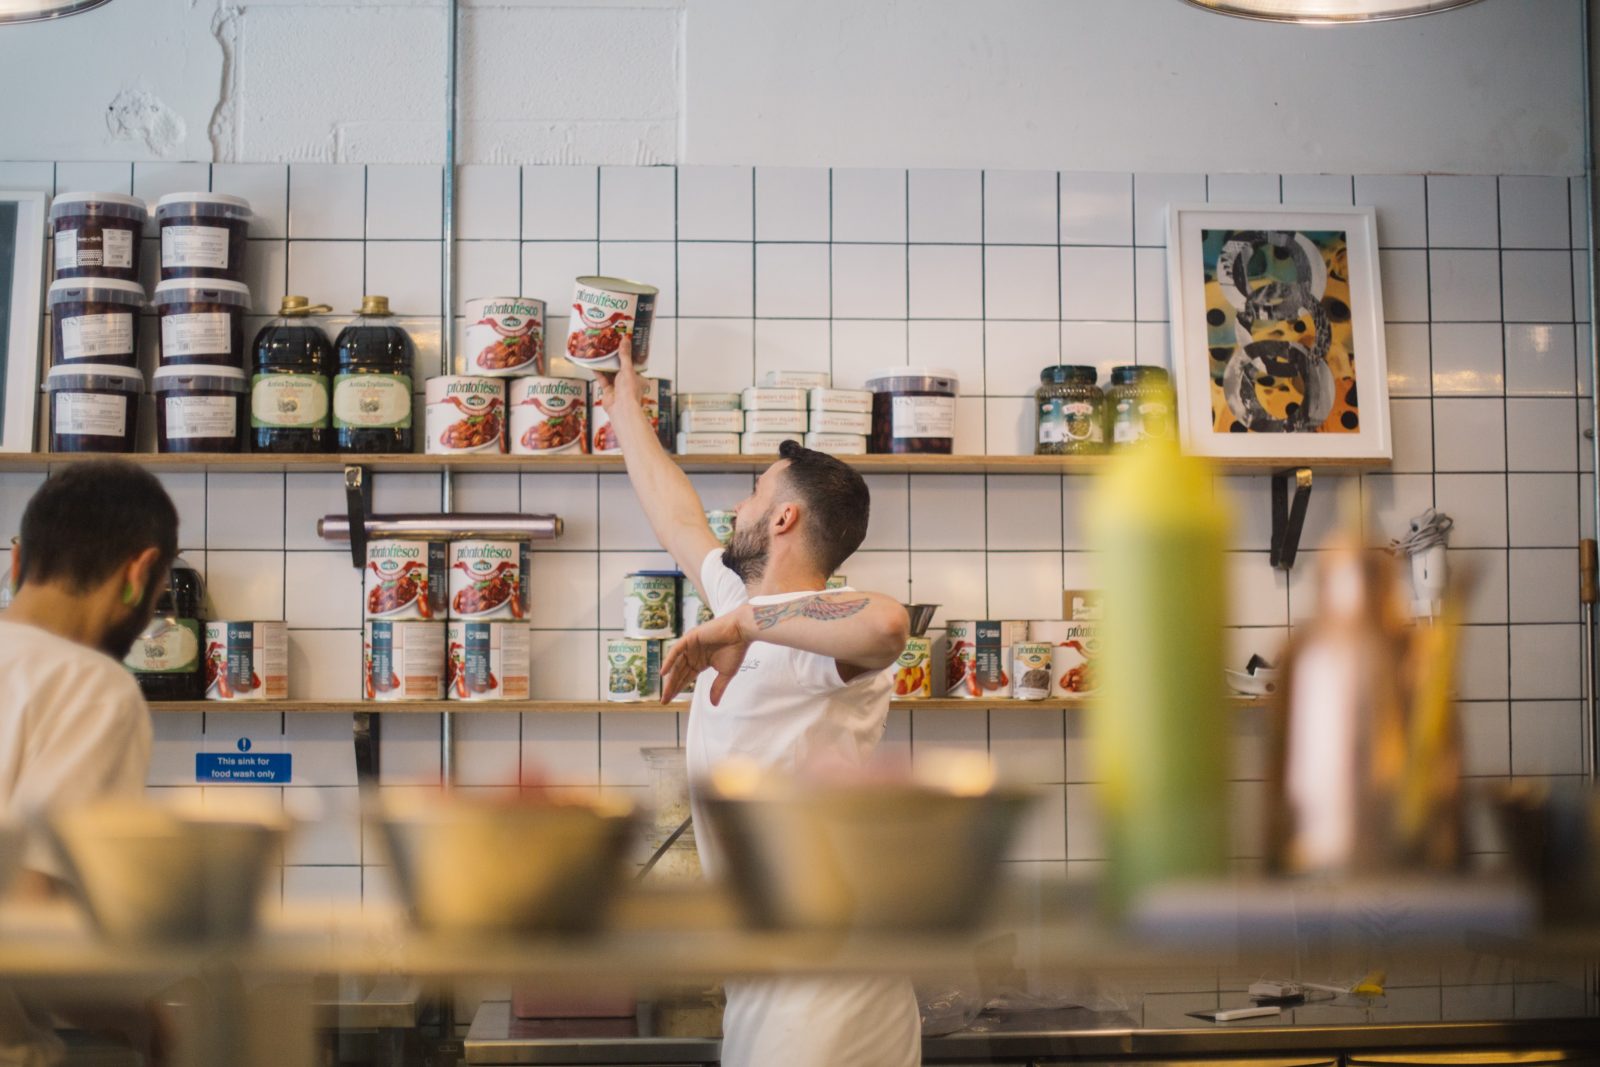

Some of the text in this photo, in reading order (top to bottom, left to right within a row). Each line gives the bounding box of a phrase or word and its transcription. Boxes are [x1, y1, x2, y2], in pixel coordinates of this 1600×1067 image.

[217, 757, 270, 765] This sink for
[211, 770, 275, 779] food wash only
